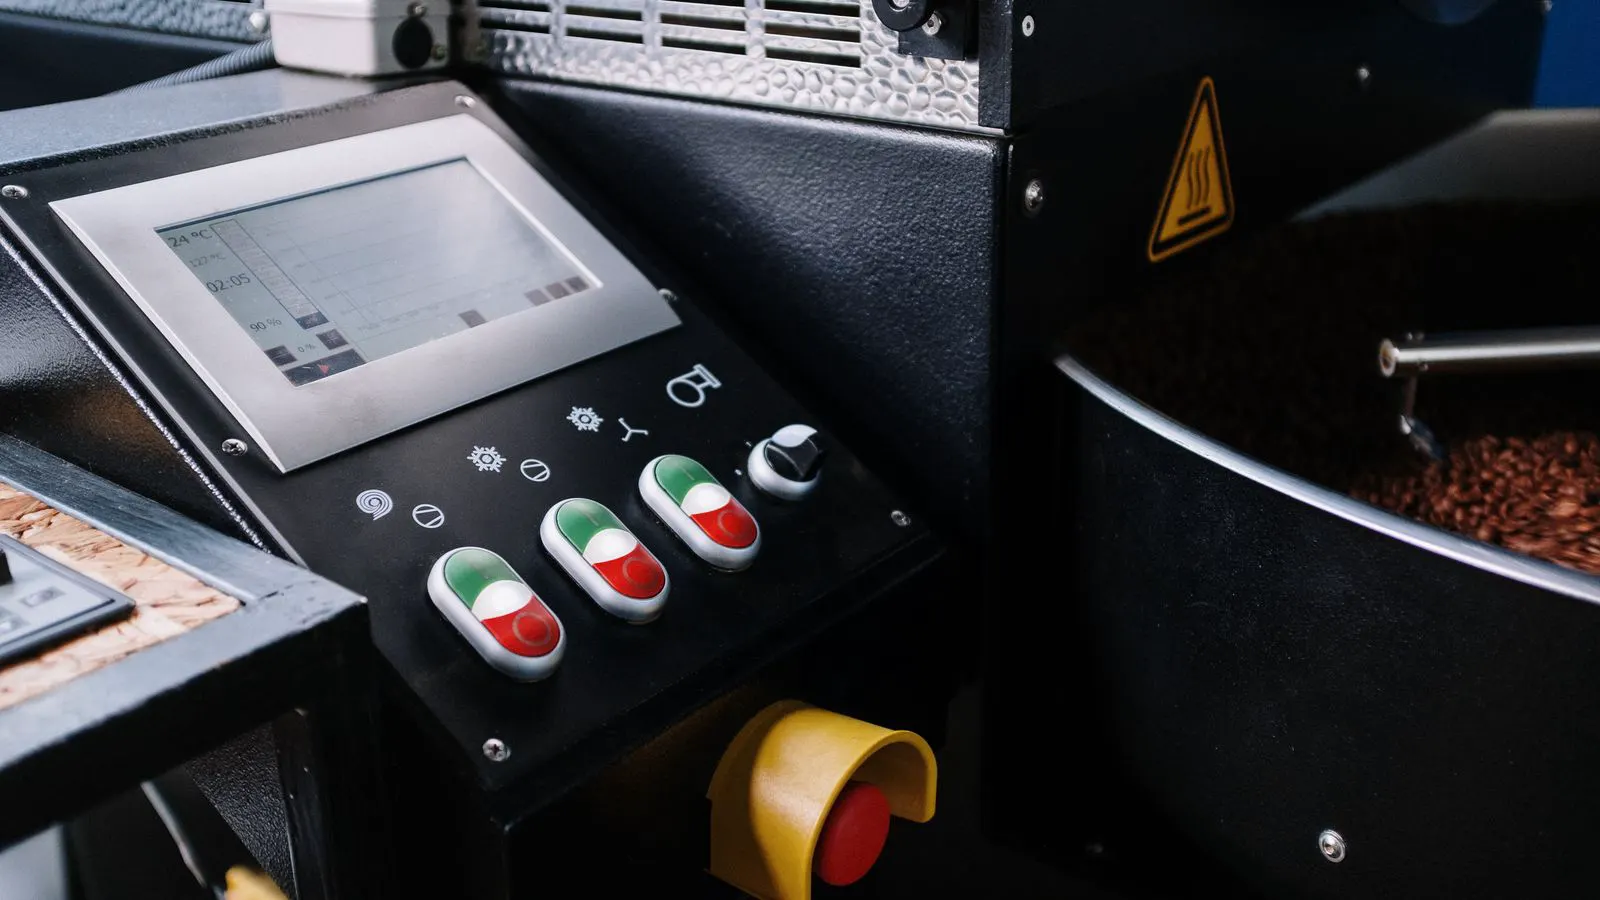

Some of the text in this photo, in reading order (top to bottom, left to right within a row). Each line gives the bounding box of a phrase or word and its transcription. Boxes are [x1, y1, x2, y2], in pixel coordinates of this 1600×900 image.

[168, 233, 189, 247] 24
[206, 273, 251, 293] 02:05
[249, 318, 282, 333] 90 %
